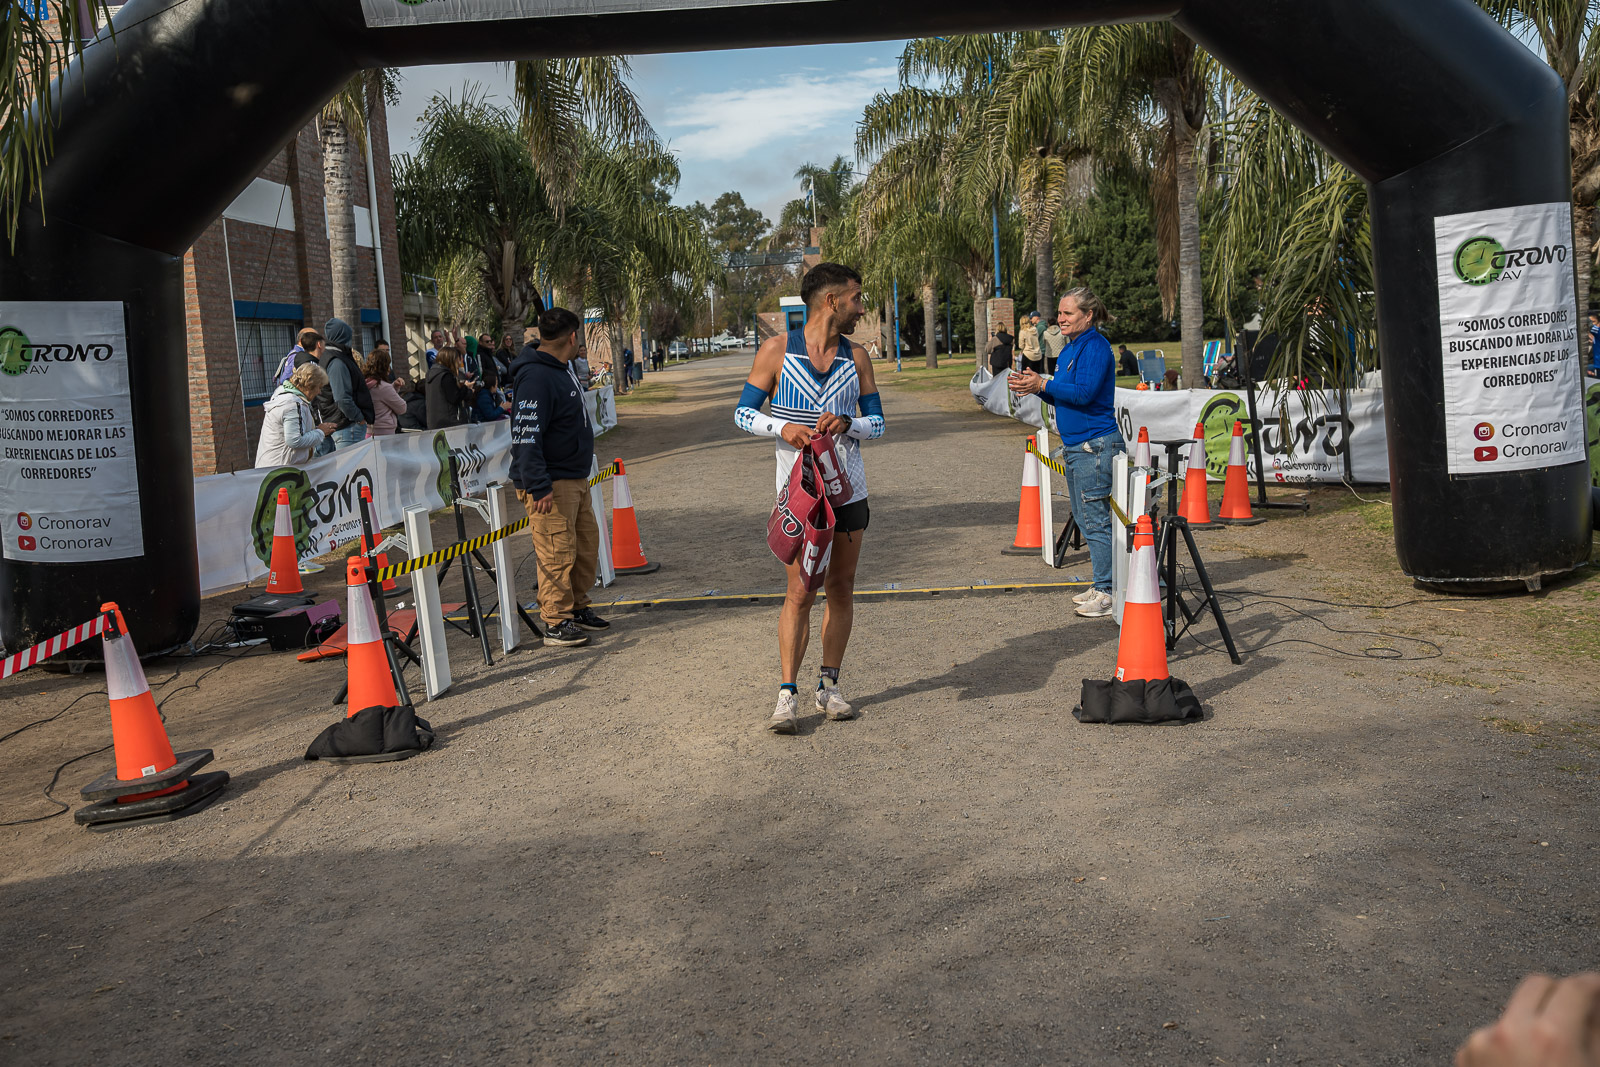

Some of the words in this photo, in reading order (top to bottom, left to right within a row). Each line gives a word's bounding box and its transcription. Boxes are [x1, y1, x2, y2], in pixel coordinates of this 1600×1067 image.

[1491, 244, 1567, 269] CRONO
[1489, 270, 1522, 283] RAV
[1508, 310, 1568, 328] CORREDORES
[1449, 335, 1513, 353] BUSCANDO
[1515, 331, 1562, 347] MEJORAR
[1562, 328, 1574, 342] LAS
[19, 343, 114, 362] CRONO
[1461, 353, 1541, 371] EXPERIENCIAS
[1543, 350, 1556, 363] DE
[1557, 348, 1570, 361] LOS
[19, 365, 50, 375] RAV
[37, 408, 115, 422] CORREDORES
[46, 428, 103, 442] MEJORAR
[104, 426, 127, 440] LAS
[1501, 421, 1568, 438] Cronorav
[4, 447, 74, 461] EXPERIENCIAS
[77, 447, 93, 460] DE
[95, 446, 117, 459] LOS
[1502, 440, 1568, 458] Cronorav
[38, 516, 112, 530] Cronorav
[39, 536, 114, 550] Cronorav
